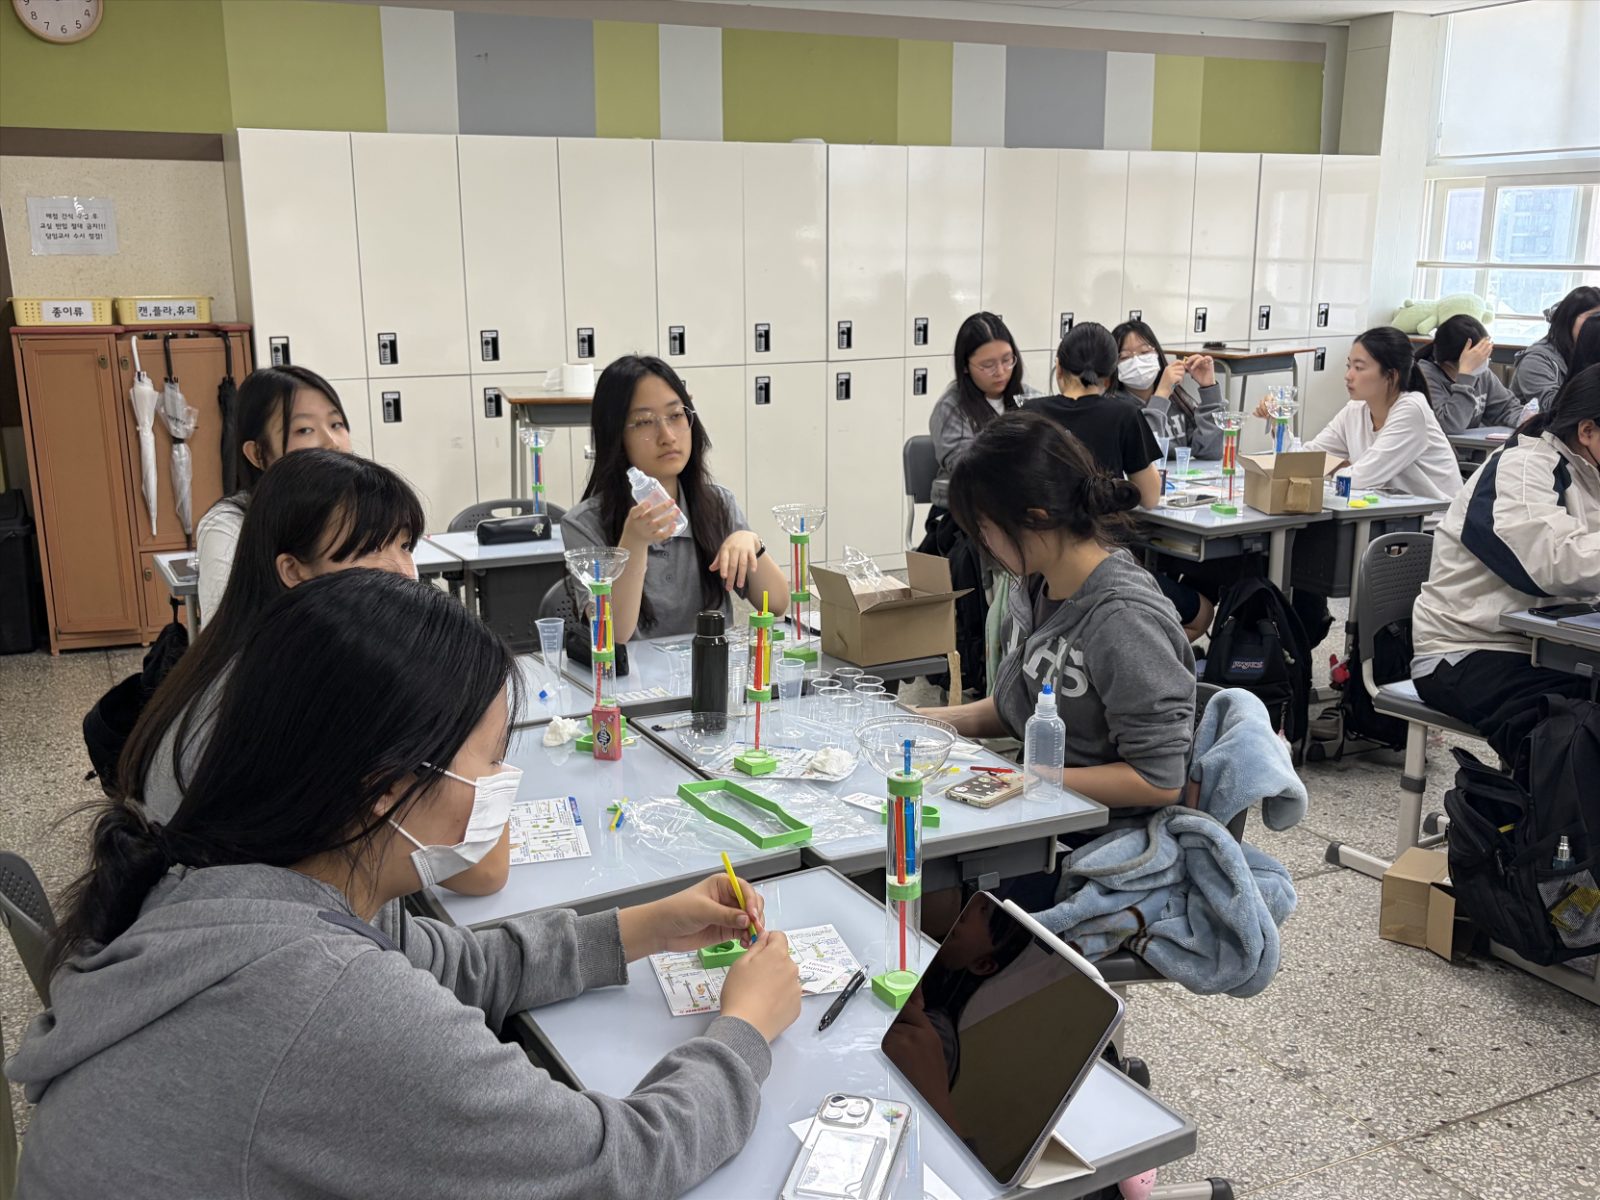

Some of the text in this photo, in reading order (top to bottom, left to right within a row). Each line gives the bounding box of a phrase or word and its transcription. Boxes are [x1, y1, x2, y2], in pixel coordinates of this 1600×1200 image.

[30, 11, 38, 20] 8
[84, 9, 91, 17] 4
[44, 22, 50, 30] 7
[75, 20, 82, 29] 5
[60, 25, 68, 34] 6
[51, 306, 84, 317] 종이류
[138, 305, 196, 317] 캔,플라,유리
